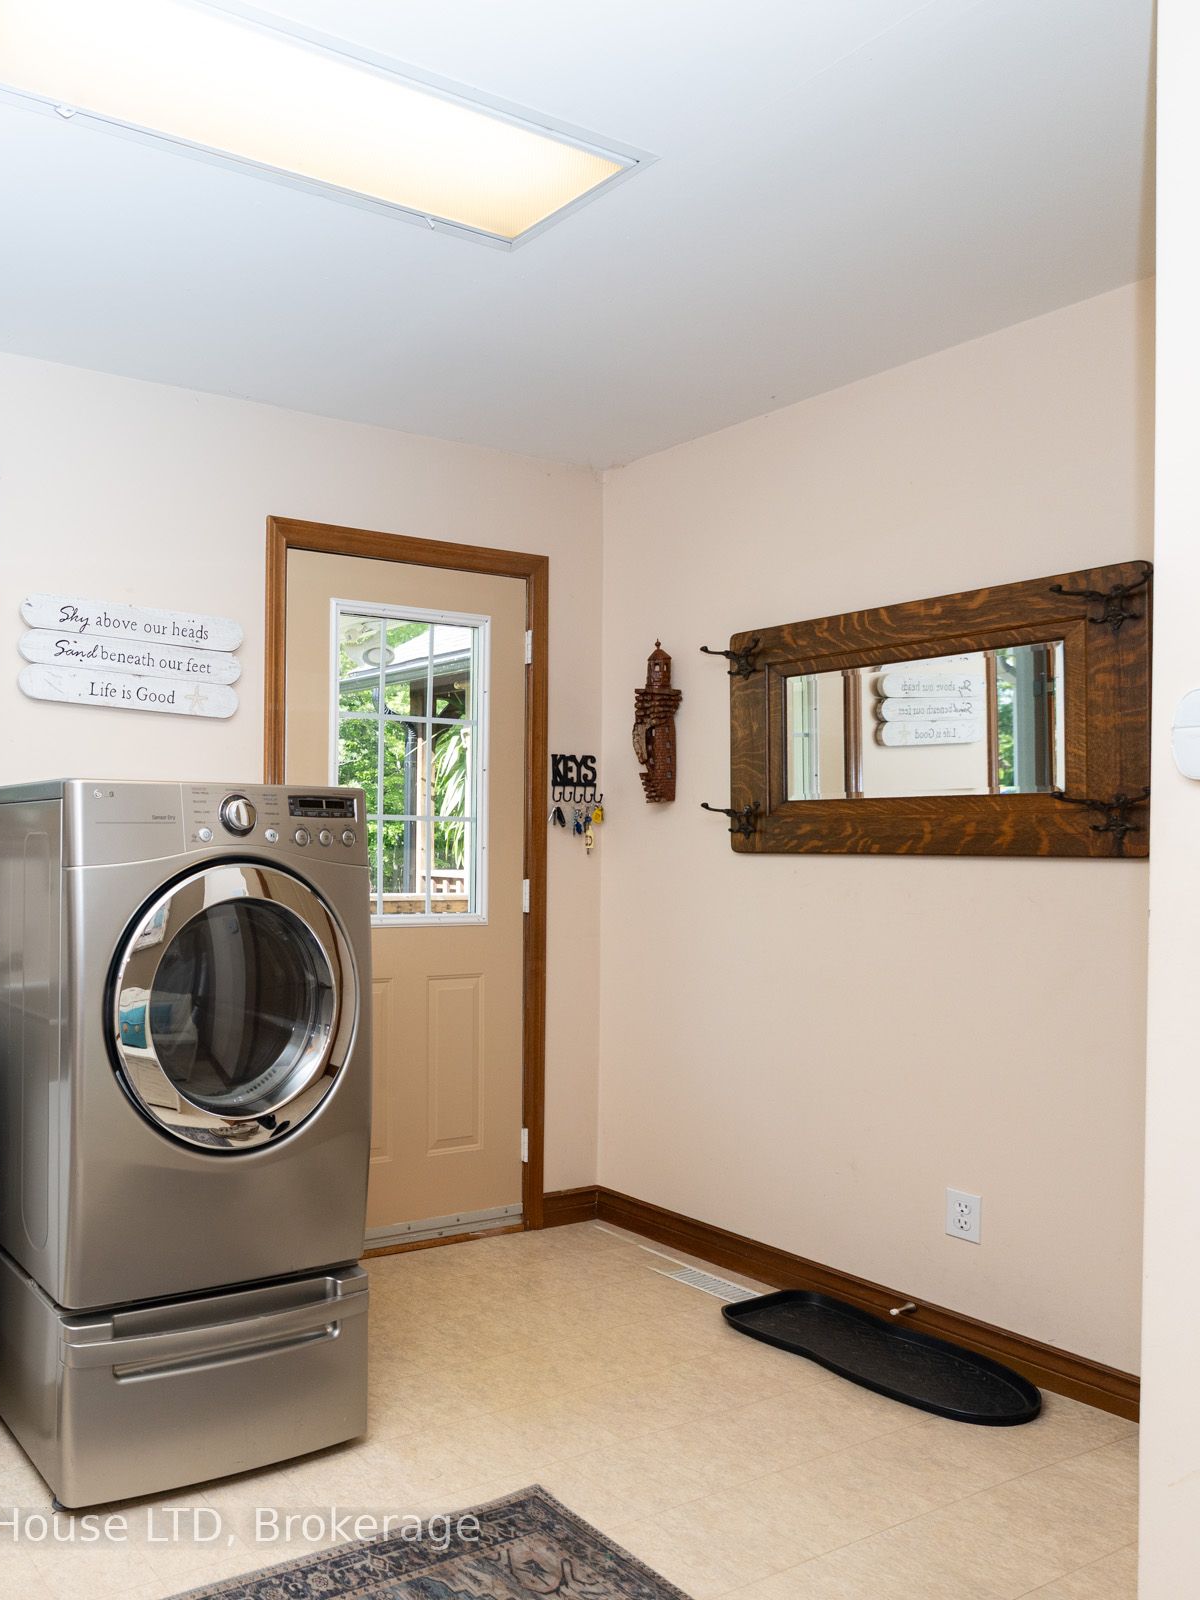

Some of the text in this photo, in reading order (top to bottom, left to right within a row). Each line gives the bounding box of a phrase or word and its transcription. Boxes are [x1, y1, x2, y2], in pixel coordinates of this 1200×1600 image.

[59, 605, 209, 640] Sky above our heads
[54, 639, 212, 674] Sand beneath our feet
[89, 681, 175, 704] Life is Good
[551, 754, 597, 785] KEYS
